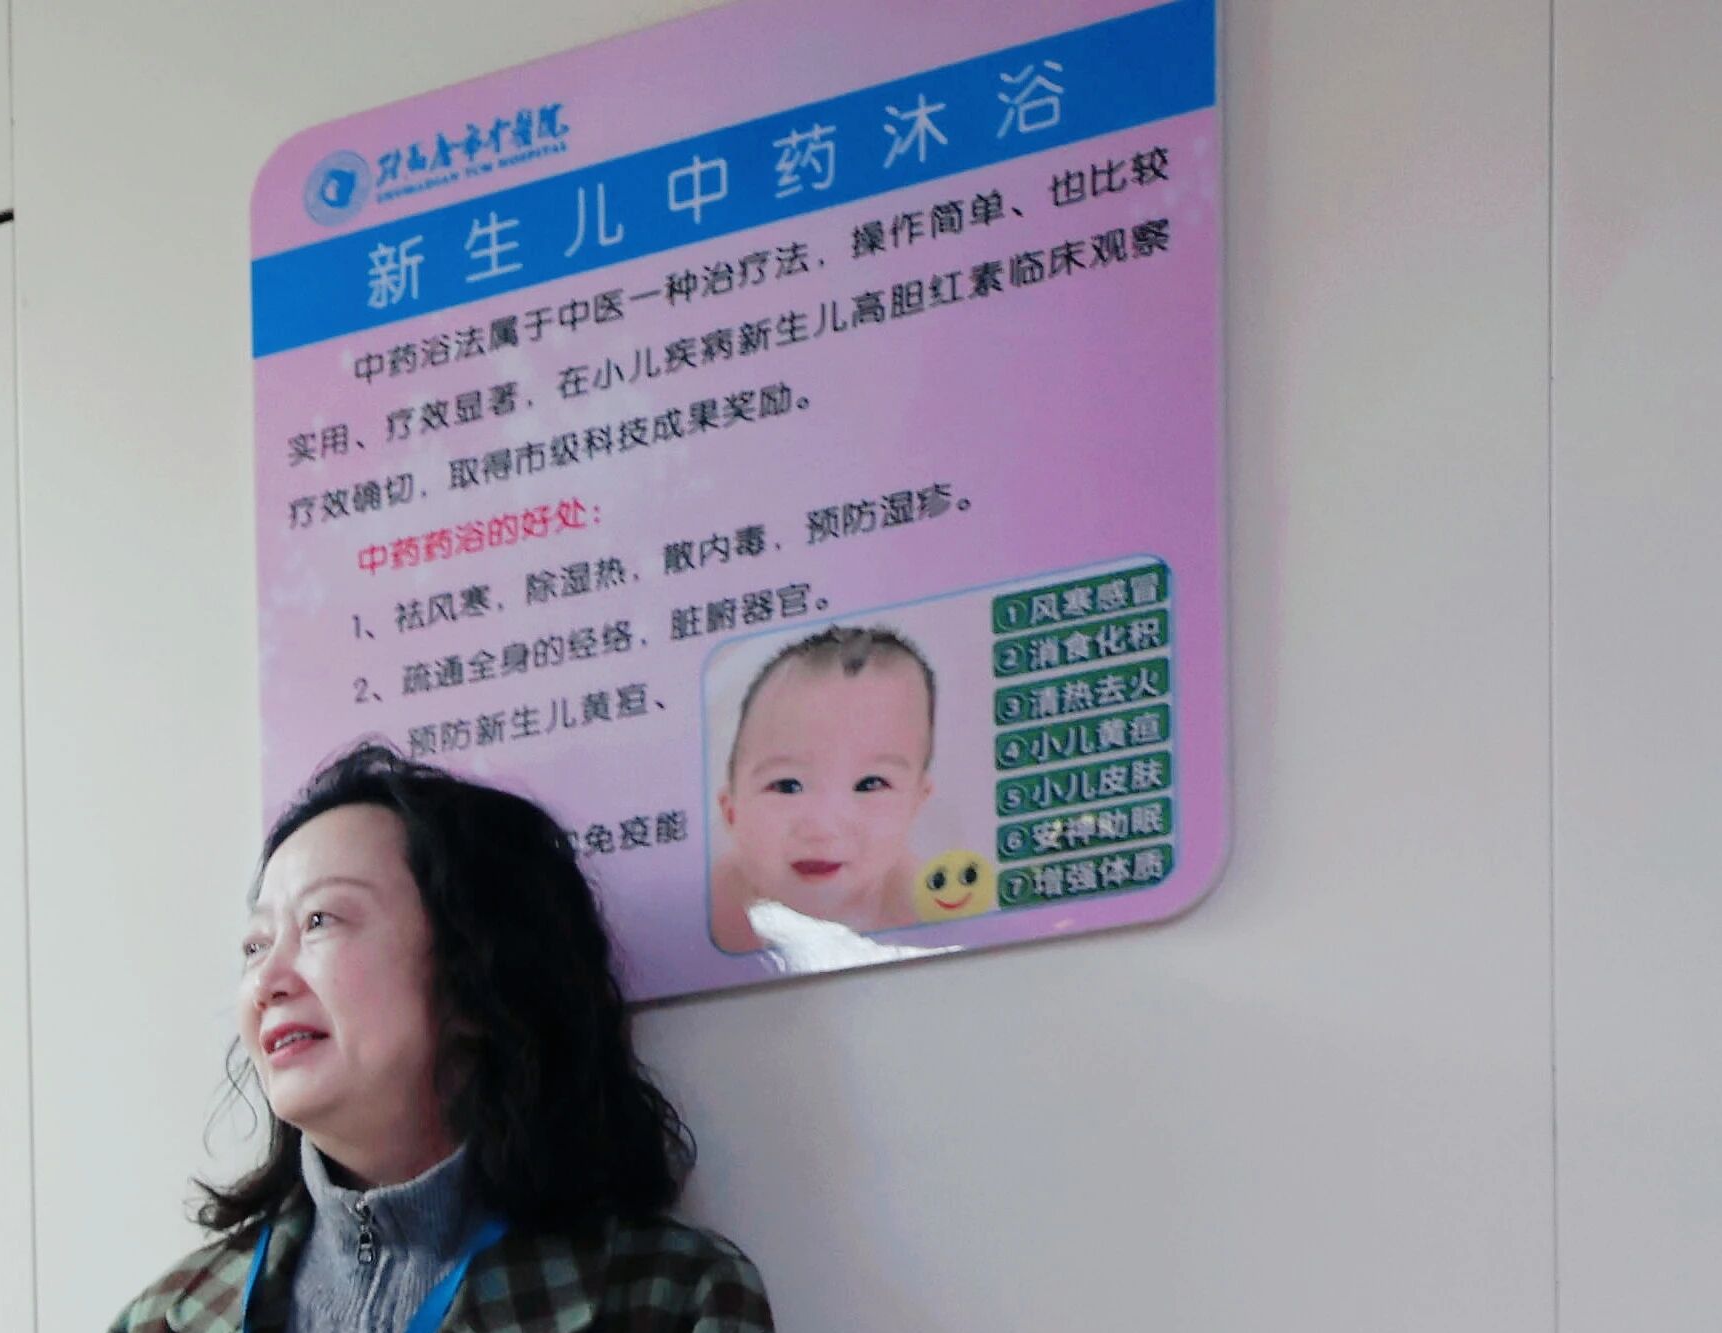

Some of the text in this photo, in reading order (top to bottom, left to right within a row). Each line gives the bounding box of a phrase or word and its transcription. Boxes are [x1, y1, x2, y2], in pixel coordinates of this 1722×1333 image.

[368, 59, 1064, 309] 新生儿中药沐浴
[564, 809, 689, 857] 免疫能
